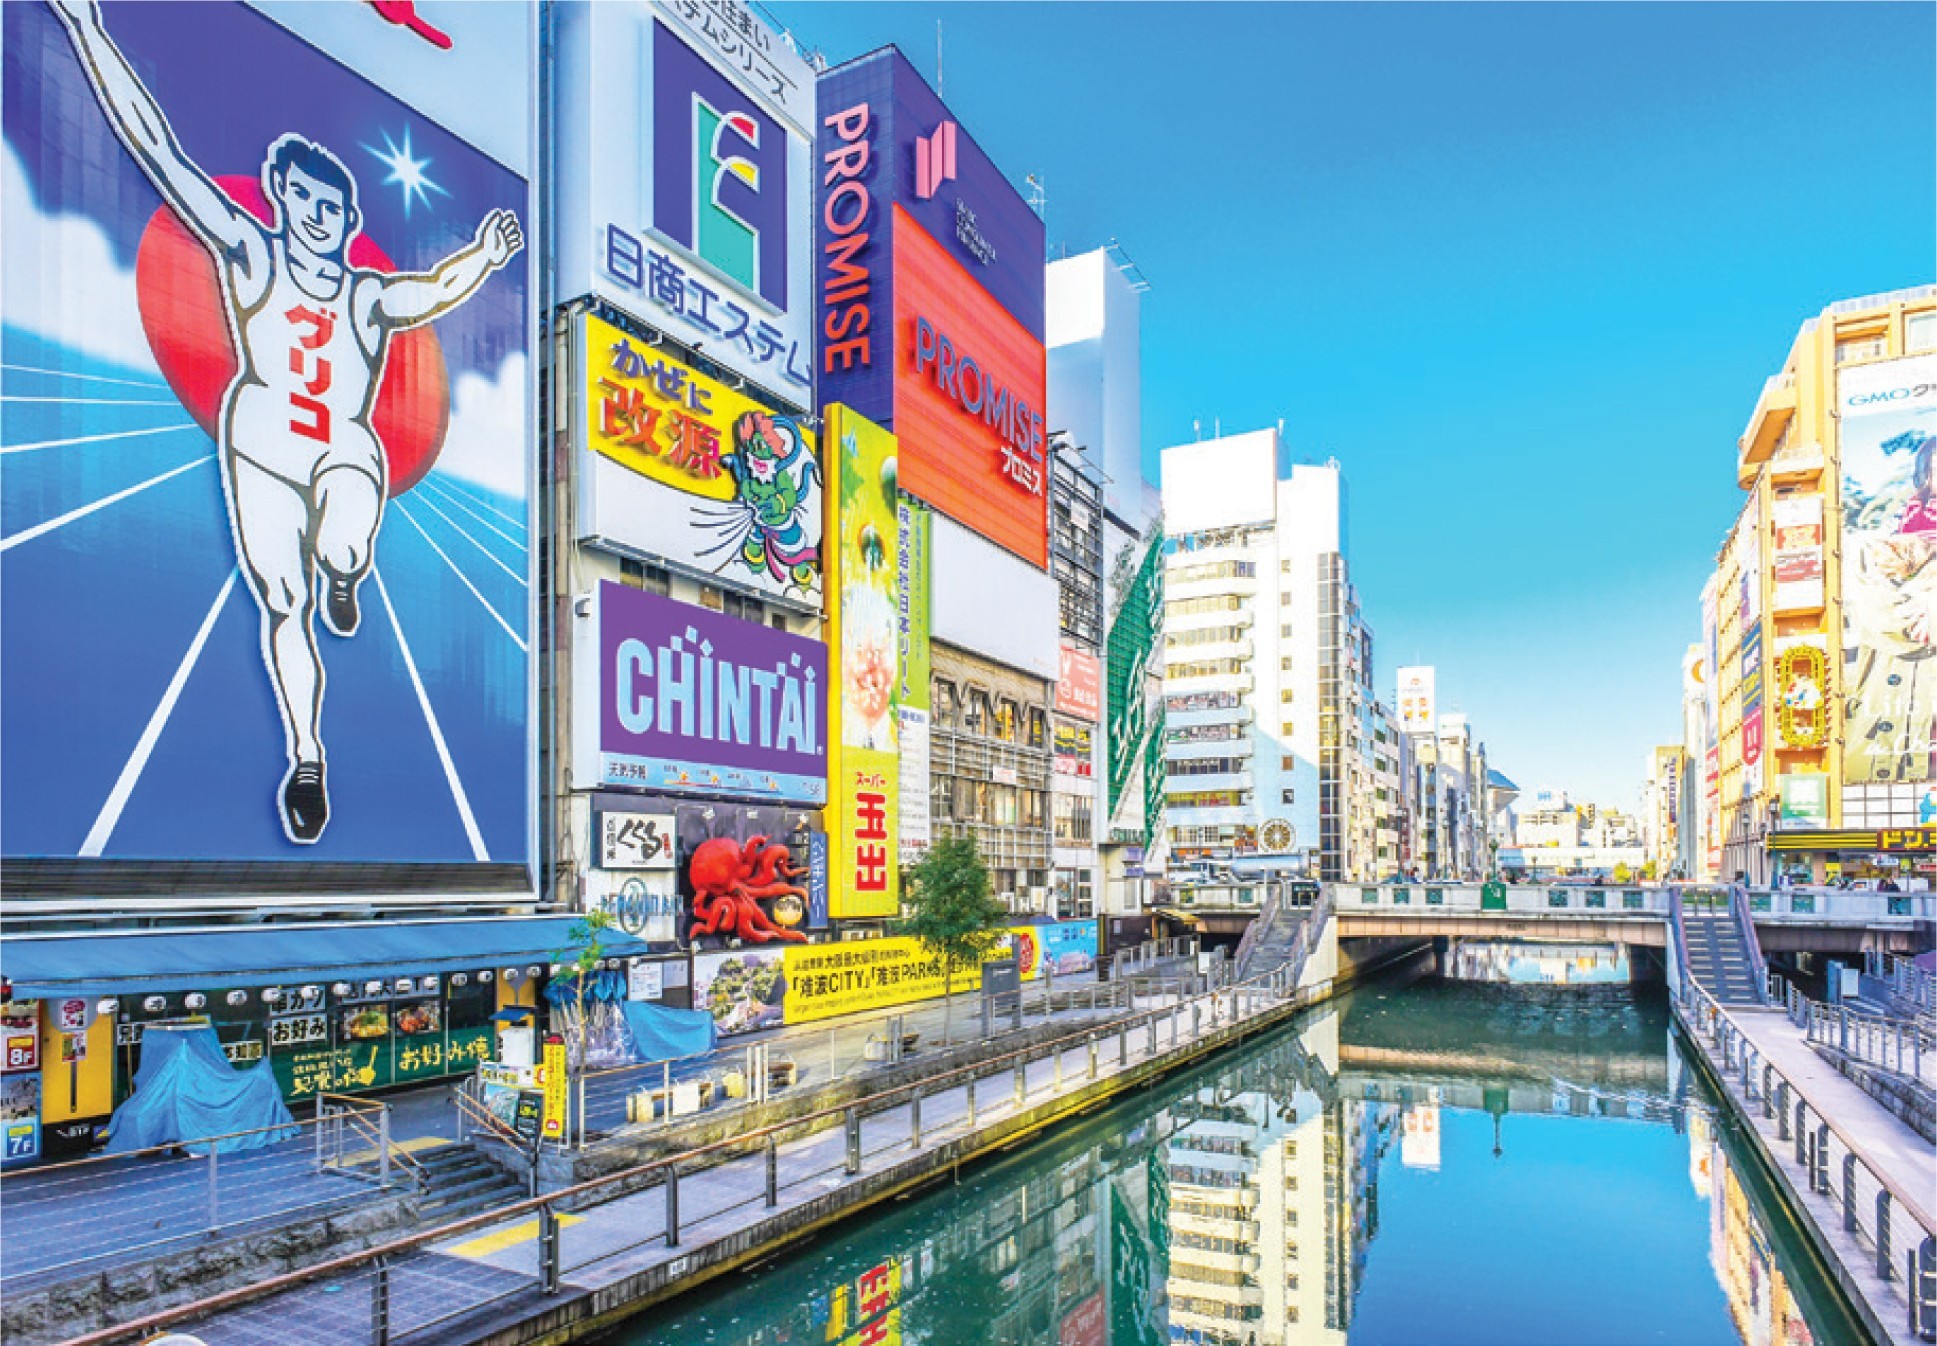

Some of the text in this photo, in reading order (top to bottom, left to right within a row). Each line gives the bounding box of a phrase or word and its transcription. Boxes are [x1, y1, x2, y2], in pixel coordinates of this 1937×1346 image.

[824, 102, 870, 375] PROMISE
[285, 304, 338, 444] グリコ
[611, 338, 714, 416] かぜに
[915, 316, 1044, 462] PROMISE
[600, 376, 722, 480] 改源
[1001, 446, 1044, 497] プロミス
[615, 625, 816, 755] CHINTAI
[855, 771, 888, 788] スーパー
[855, 792, 888, 892] 玉出
[10, 1048, 33, 1065] 8F
[273, 1017, 325, 1043] お好み
[10, 1137, 32, 1155] 7F
